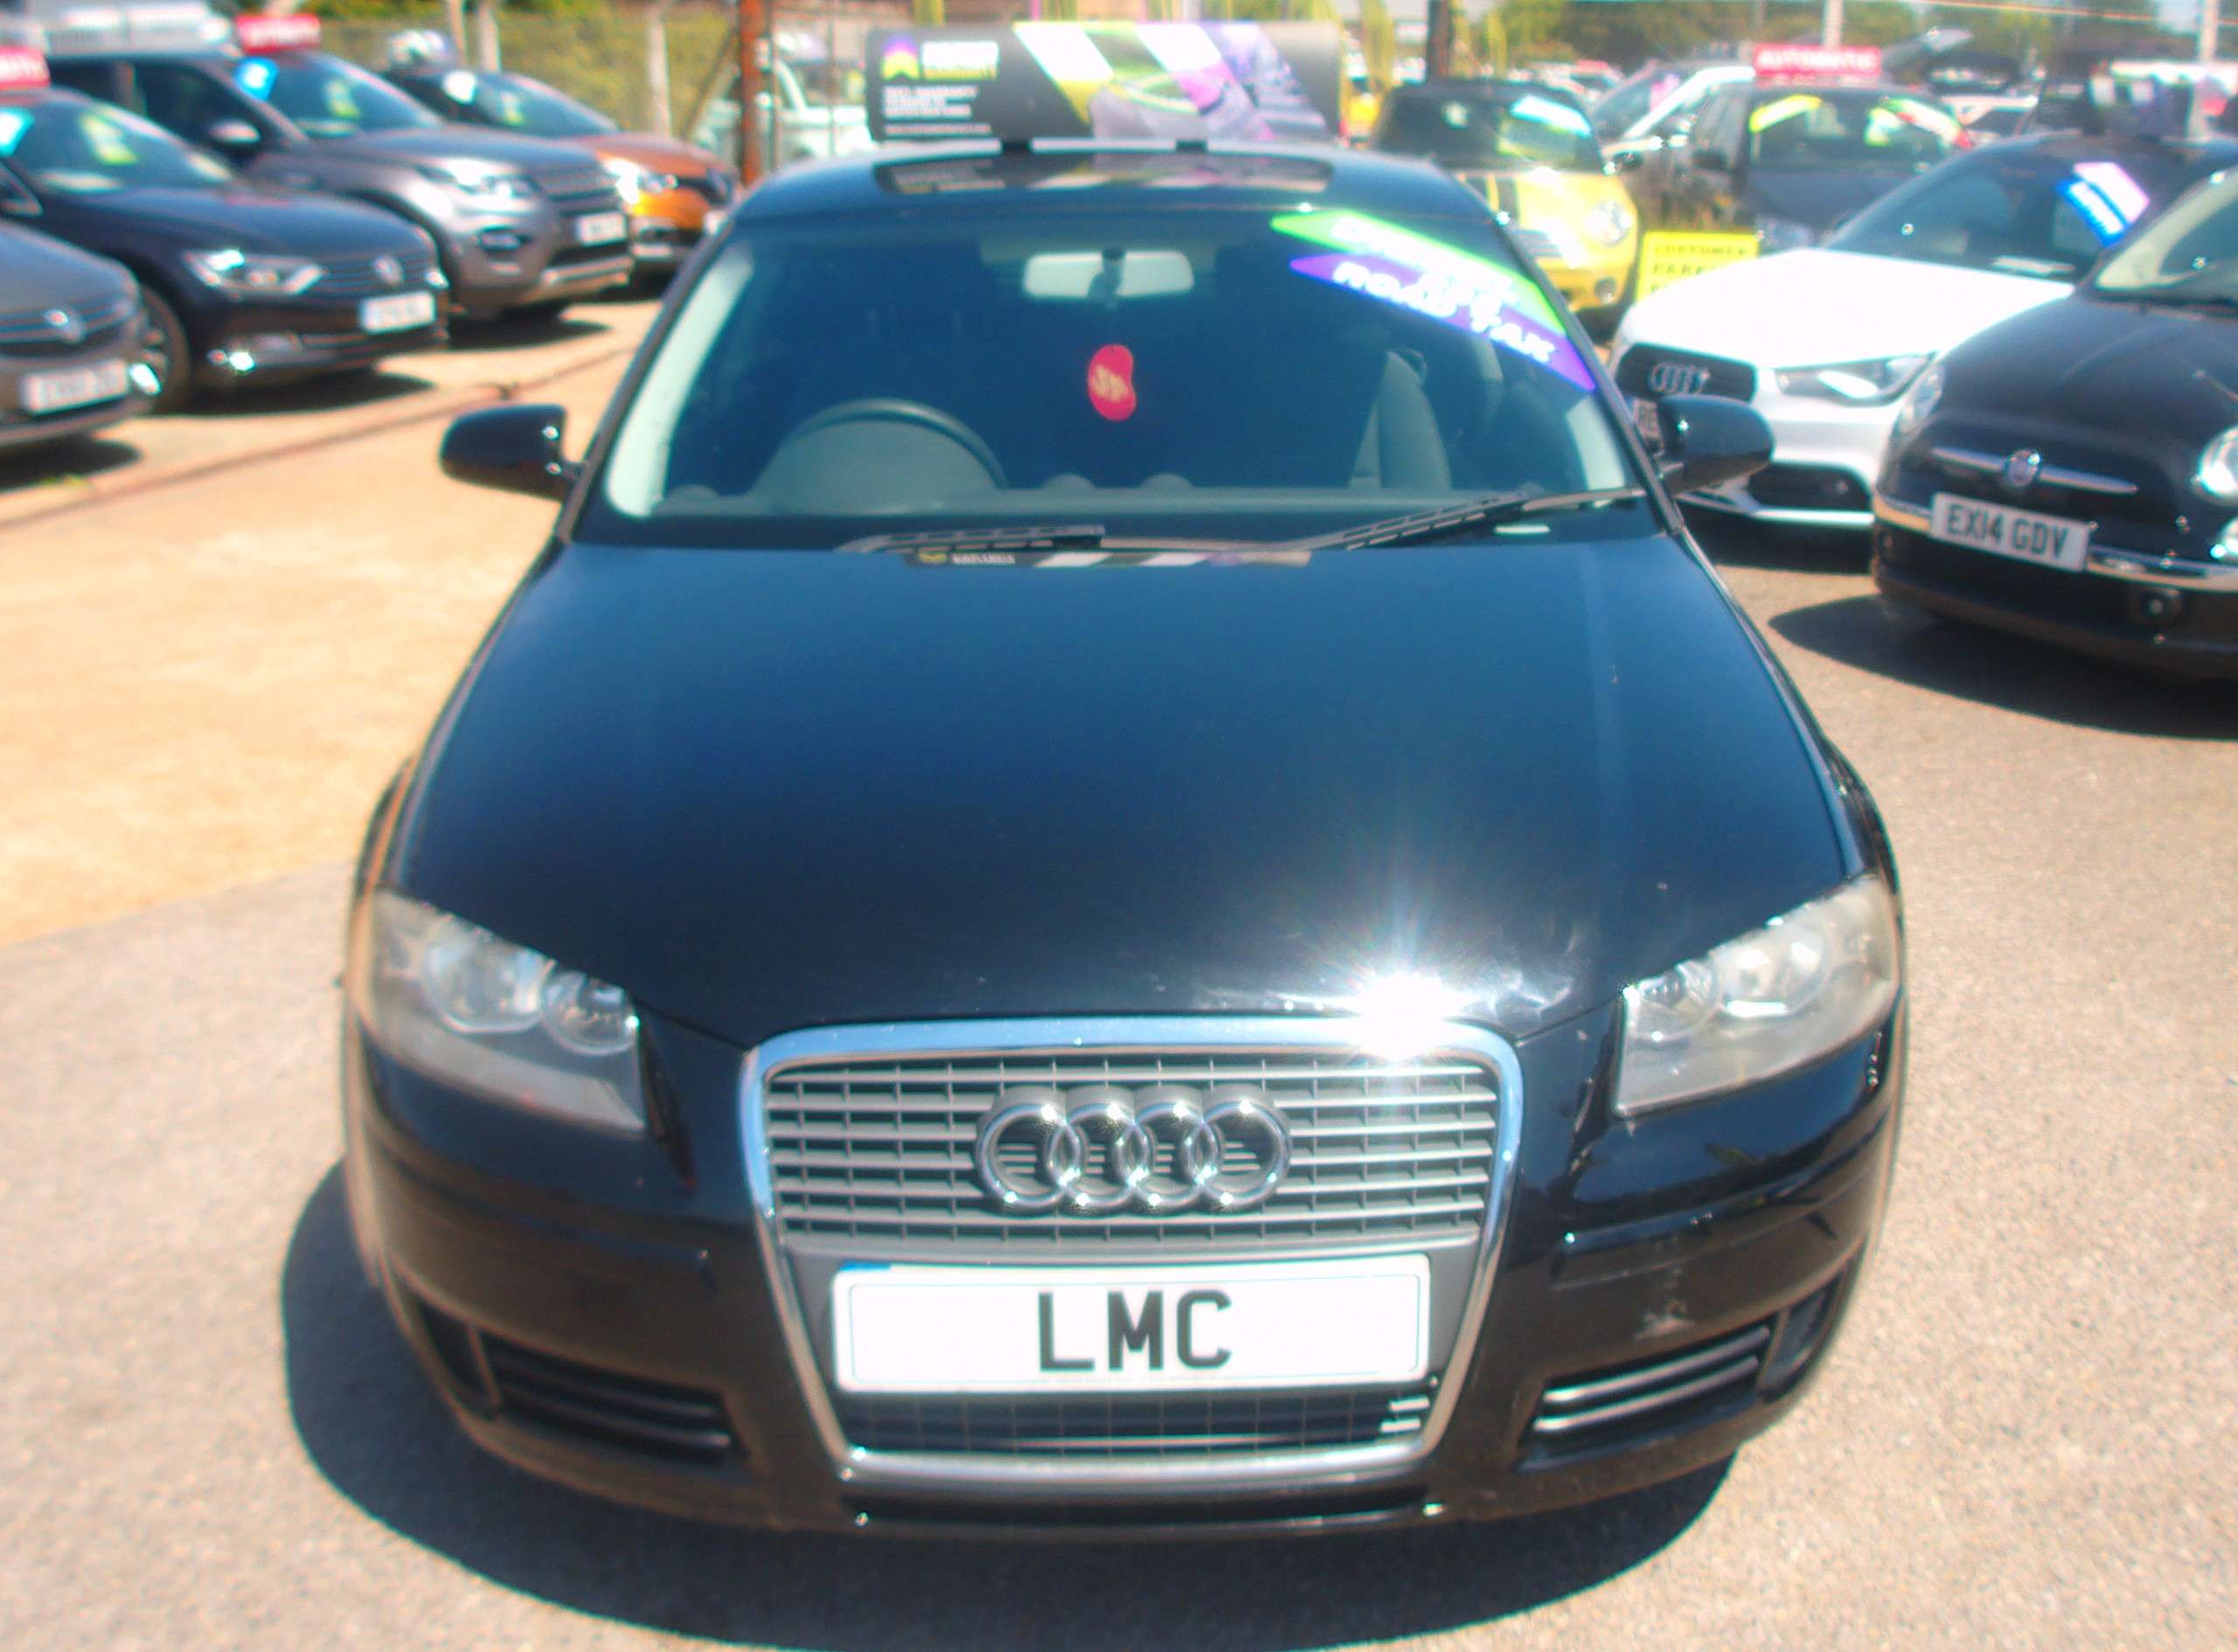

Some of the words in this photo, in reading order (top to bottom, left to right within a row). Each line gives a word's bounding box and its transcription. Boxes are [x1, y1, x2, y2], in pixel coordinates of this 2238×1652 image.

[1946, 503, 2002, 544] EX14
[2012, 517, 2070, 559] GDV
[1038, 1288, 1232, 1371] LMC
